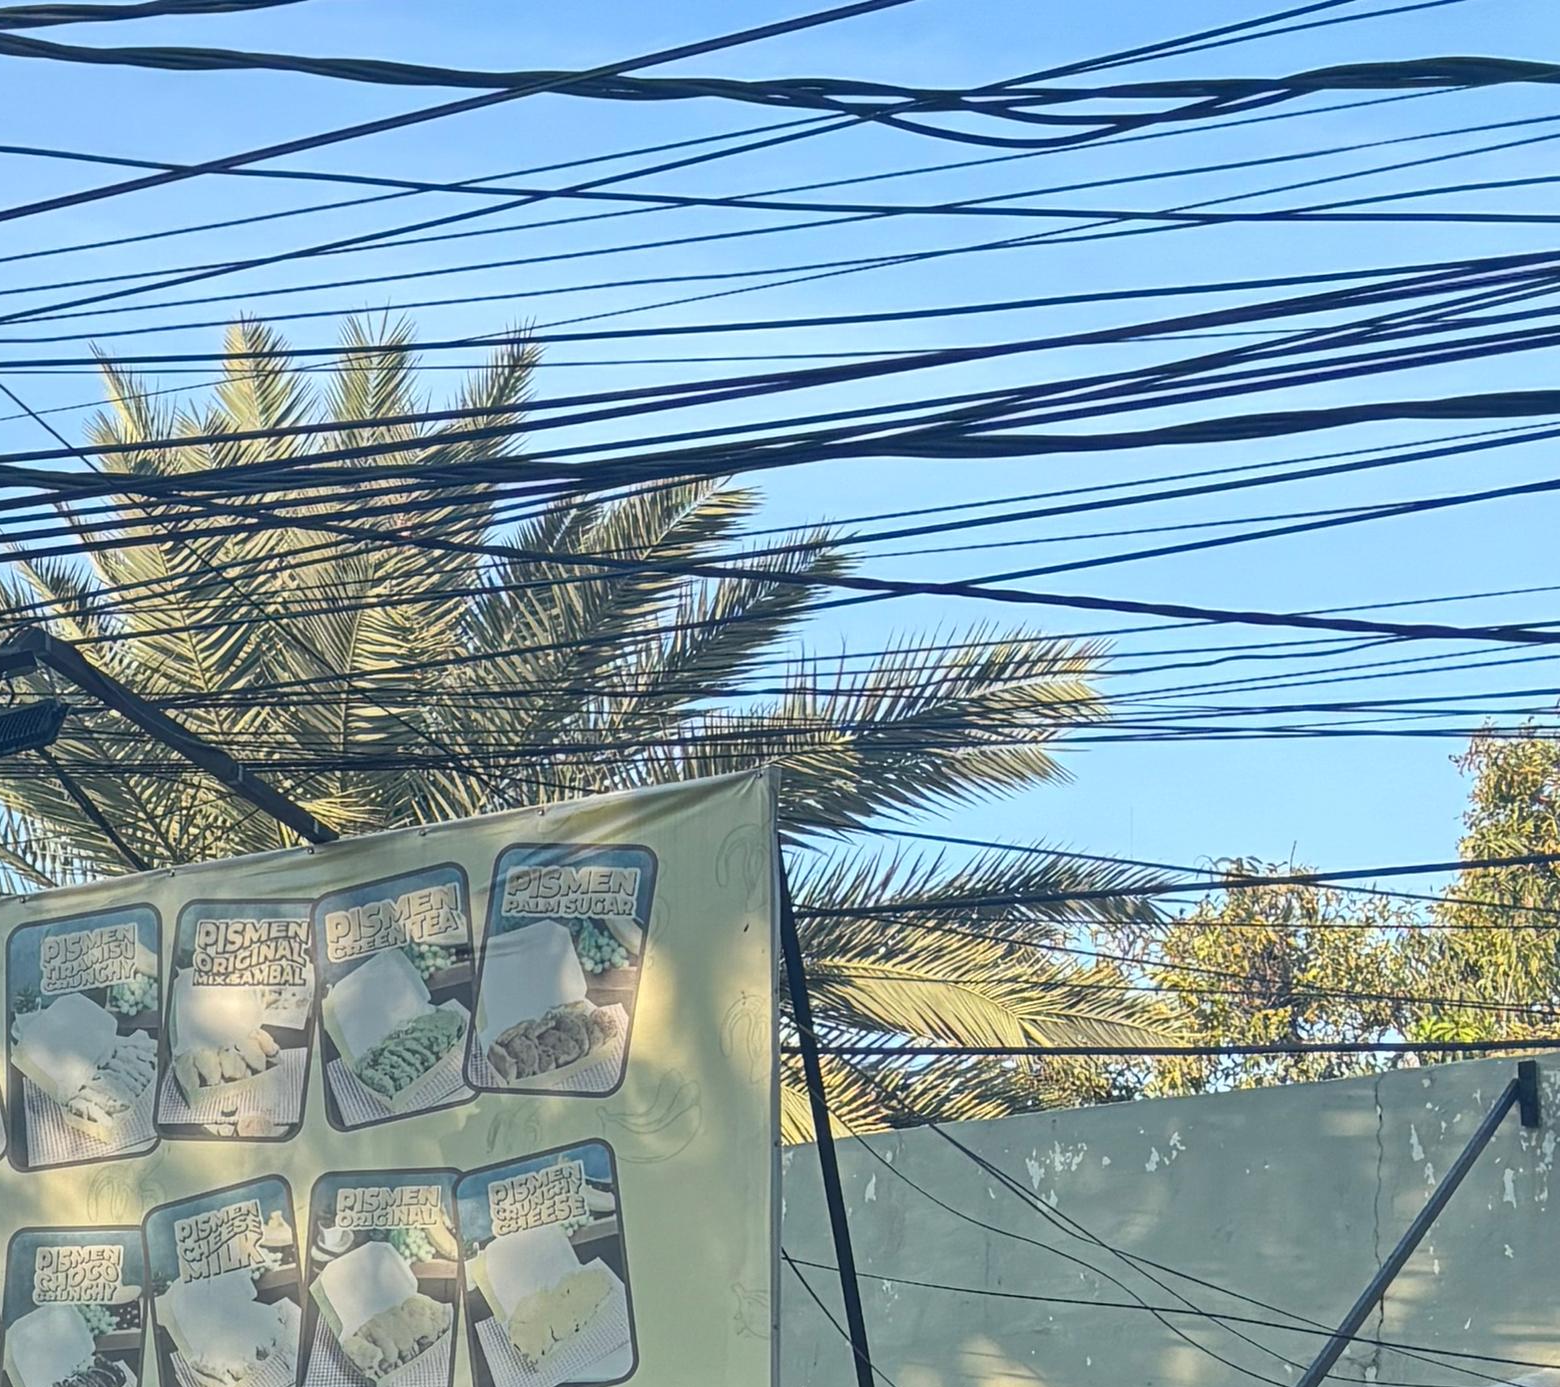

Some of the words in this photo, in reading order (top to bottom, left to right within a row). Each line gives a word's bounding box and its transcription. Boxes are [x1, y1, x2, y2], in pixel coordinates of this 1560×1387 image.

[508, 868, 638, 899] PISMEN
[328, 884, 460, 944] PISMEN
[504, 899, 560, 915] PALM
[564, 898, 634, 916] SUGAR
[43, 924, 137, 963] PISMEN
[197, 919, 311, 953] PISMEN
[409, 911, 461, 940] TEA
[45, 942, 137, 980] TIRAMISU
[194, 938, 307, 974] ORIGINAL
[44, 961, 139, 993] CRUNCHY
[338, 1186, 440, 1213] PISMEN
[491, 1162, 584, 1206] PISMEN
[494, 1181, 584, 1222] CRUNCHY
[177, 1201, 261, 1245] PISMEN
[337, 1207, 439, 1229] ORIGINAL
[496, 1198, 586, 1237] CHEESE
[181, 1217, 263, 1263] CHEESE
[37, 1247, 121, 1273] PISMEN
[183, 1233, 266, 1284] MILK
[36, 1262, 120, 1292] CHOCO
